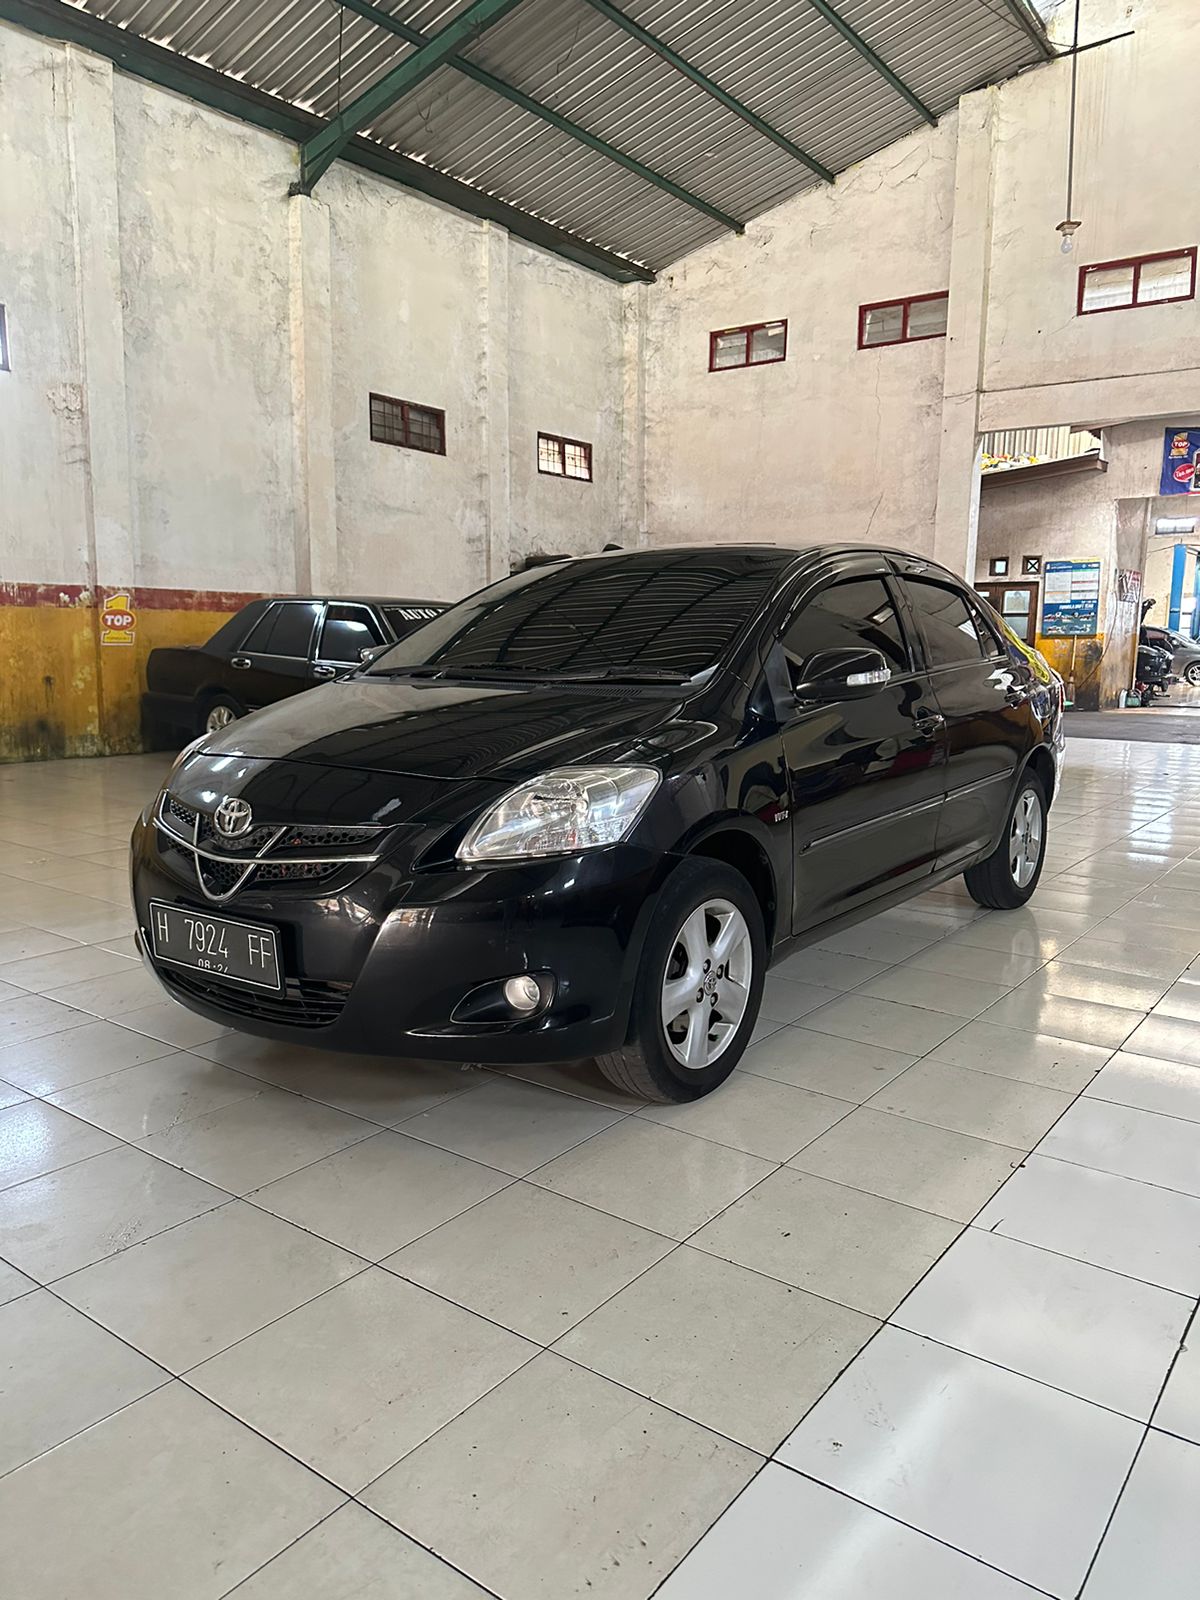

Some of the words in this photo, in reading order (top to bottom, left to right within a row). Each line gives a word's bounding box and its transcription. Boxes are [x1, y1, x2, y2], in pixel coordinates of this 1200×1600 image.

[105, 614, 132, 626] TOP
[157, 911, 169, 942] H
[184, 918, 229, 958] 7924
[247, 934, 272, 968] FF
